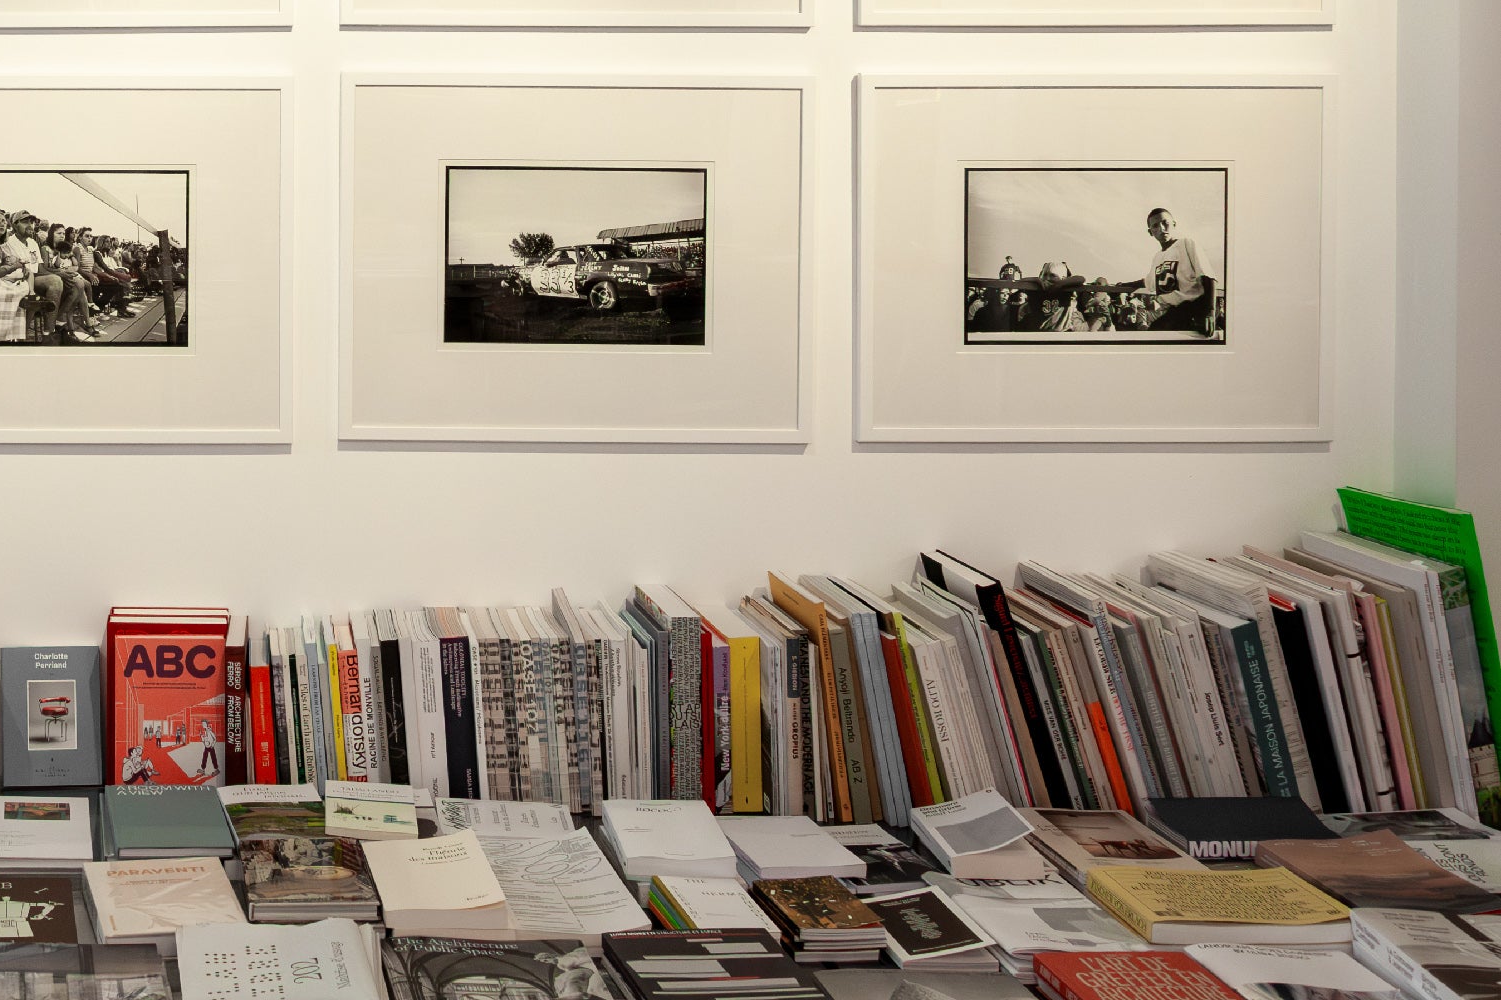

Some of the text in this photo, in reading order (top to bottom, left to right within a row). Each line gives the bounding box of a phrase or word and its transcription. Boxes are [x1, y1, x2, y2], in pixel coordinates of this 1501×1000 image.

[33, 652, 69, 660] Charlotte
[35, 661, 67, 670] Perriand
[123, 644, 216, 679] ABC
[226, 661, 235, 690] FERRO
[520, 644, 536, 695] OASE
[226, 695, 235, 715] FROM
[799, 634, 813, 796] PIRANESI AND THE MODERN AGE
[926, 679, 950, 743] ALDO ROSSI
[234, 695, 242, 753] ARCHITECTURE
[363, 677, 378, 769] RACINE DE MONVILLE
[1247, 659, 1288, 787] LA MAISON JAPONAISE
[719, 754, 729, 771] New
[107, 866, 206, 876] PARAVENTI
[394, 944, 504, 956] of Public Space
[426, 938, 518, 950] Architecture
[1142, 957, 1178, 971] DE
[1075, 970, 1217, 988] GREFFER EN
